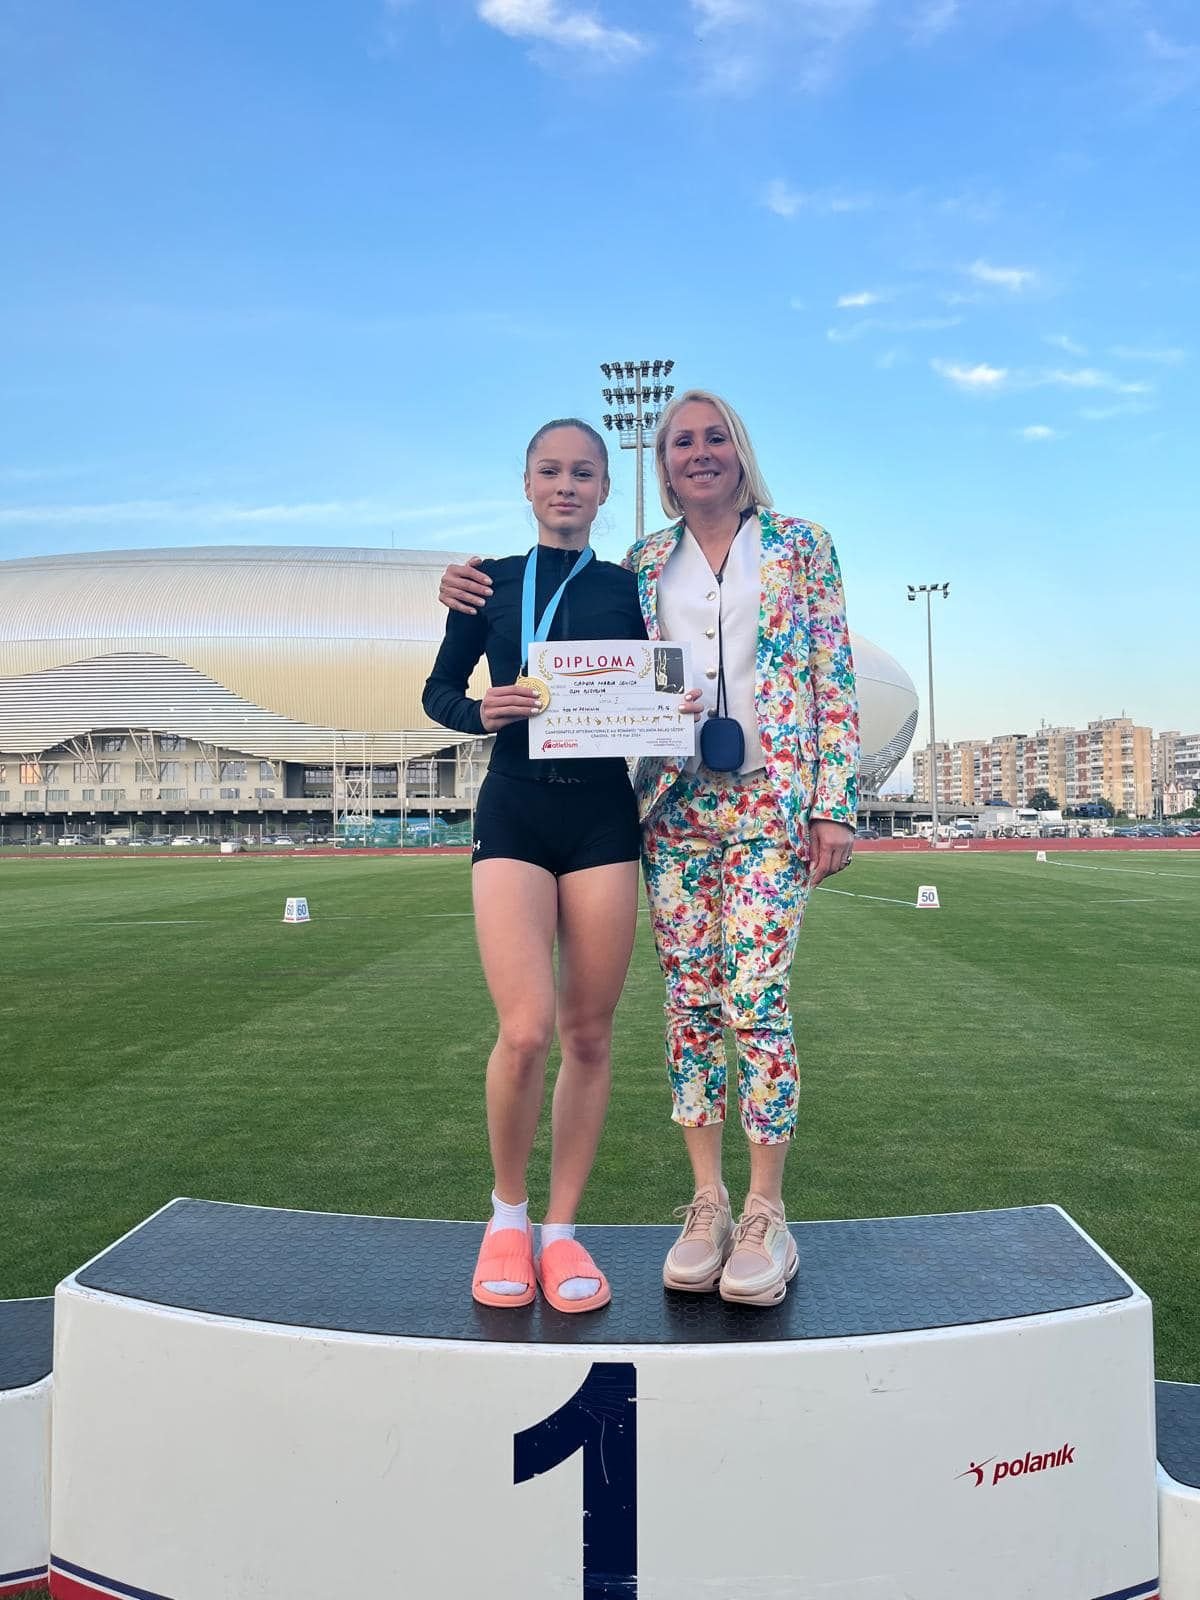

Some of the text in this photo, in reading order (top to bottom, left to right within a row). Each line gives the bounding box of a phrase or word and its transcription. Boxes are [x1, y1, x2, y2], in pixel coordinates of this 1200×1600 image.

[554, 655, 635, 669] DIPLOMA
[551, 741, 578, 749] atletism
[921, 891, 935, 903] 50
[297, 903, 307, 916] 60
[992, 1443, 1075, 1486] polanik
[514, 1362, 637, 1600] 1
